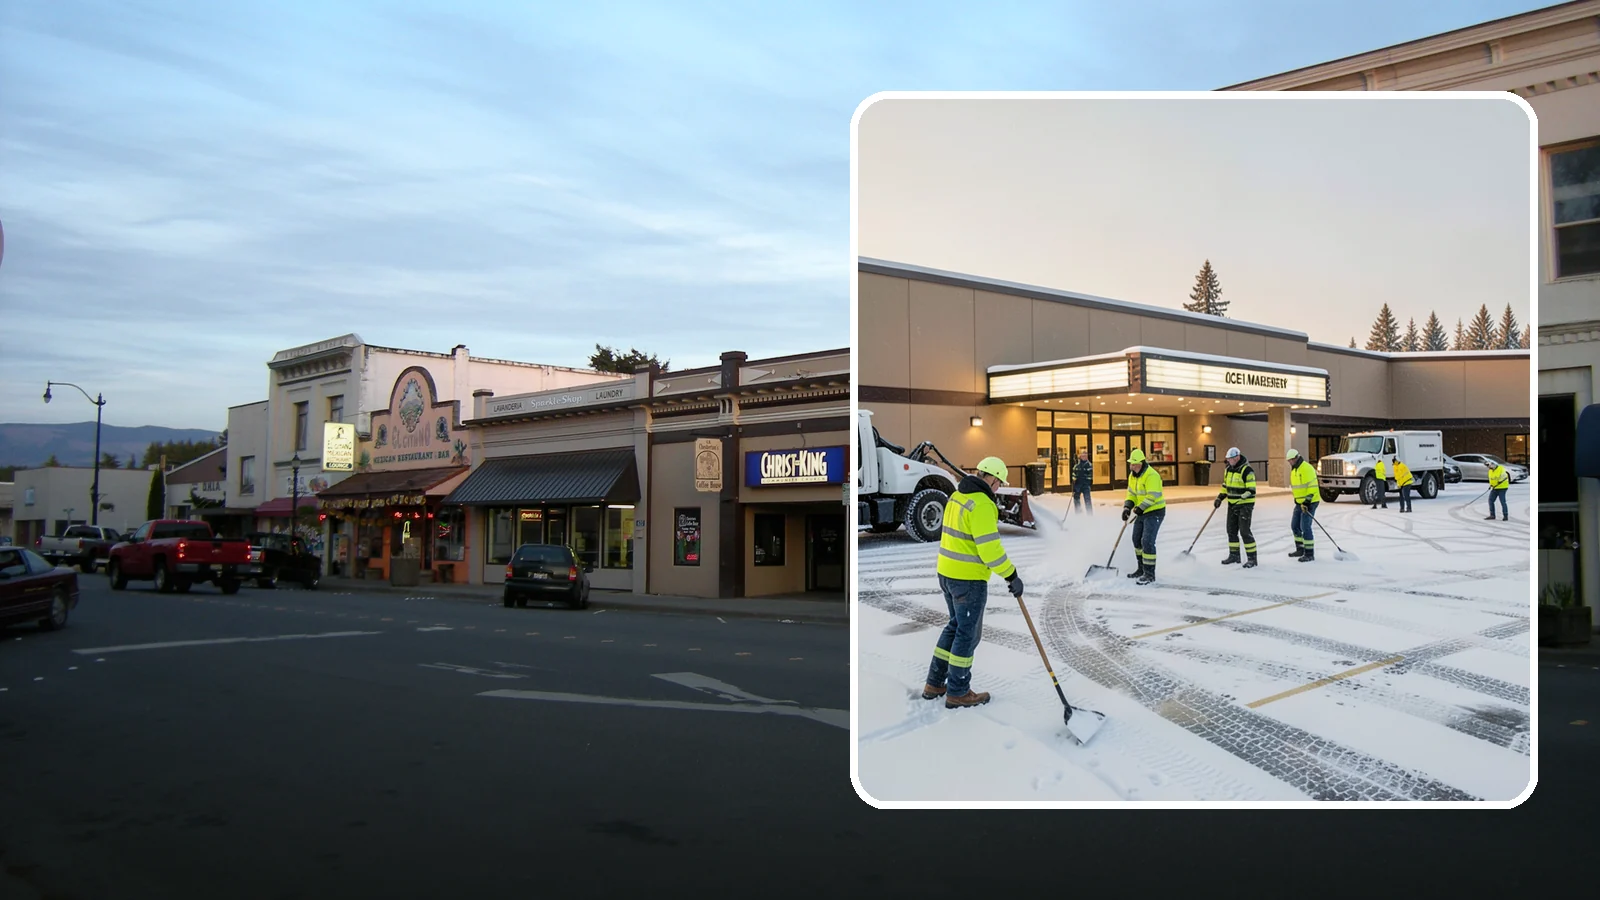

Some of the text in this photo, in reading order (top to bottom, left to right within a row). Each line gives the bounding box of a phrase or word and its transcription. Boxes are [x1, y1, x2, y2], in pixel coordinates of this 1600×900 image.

[530, 394, 582, 409] Sparkle Shop
[596, 389, 624, 400] LAUNDRY
[494, 402, 522, 412] LAVANDERIA
[373, 455, 396, 464] MEXICAN
[398, 452, 433, 462] RESTAURANT
[438, 450, 450, 459] BAR
[761, 450, 827, 478] CHRIST KING
